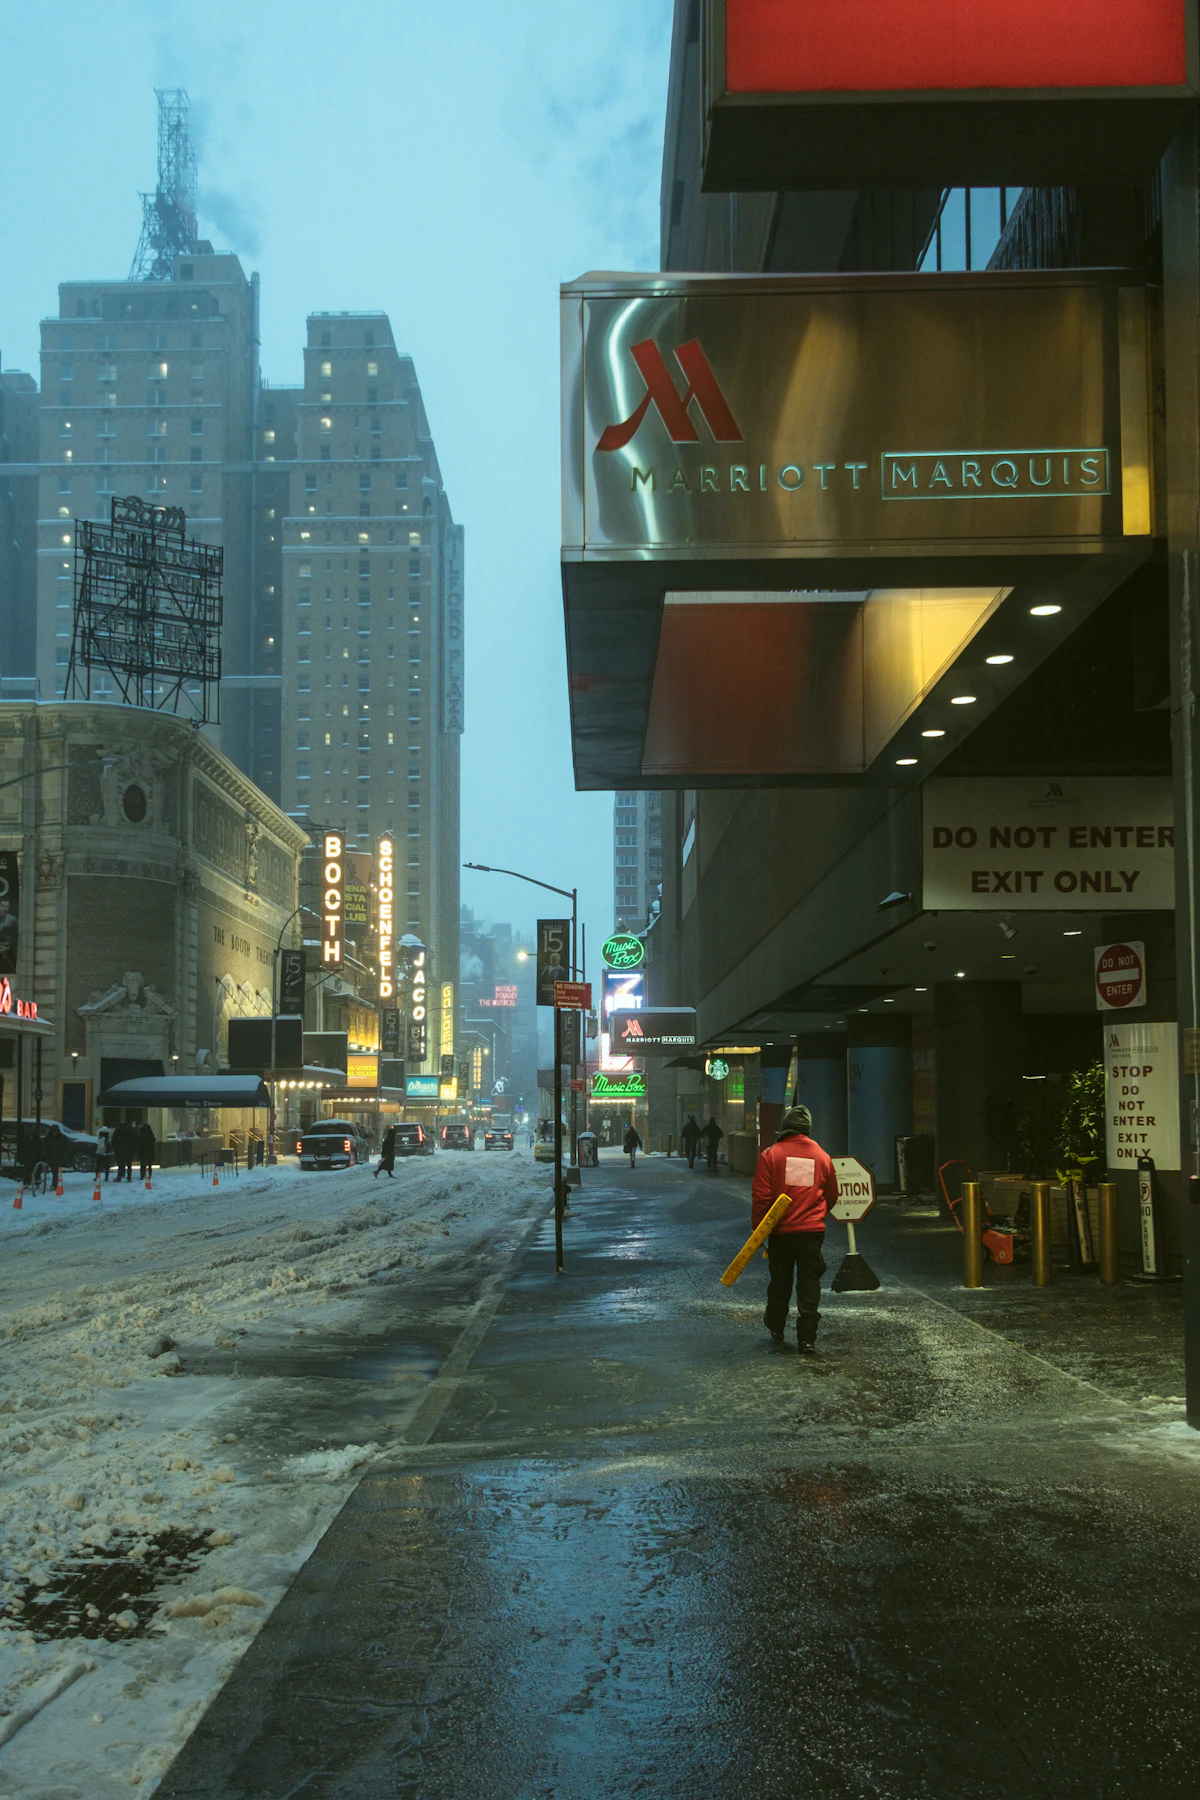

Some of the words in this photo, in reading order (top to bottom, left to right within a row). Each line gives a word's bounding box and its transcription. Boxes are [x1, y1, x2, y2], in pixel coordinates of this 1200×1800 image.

[632, 461, 868, 494] MARRIOTT
[890, 457, 1103, 489] MARQUIS
[933, 827, 978, 849] DO
[989, 827, 1057, 849] NOT
[1069, 826, 1175, 848] ENTER
[971, 870, 1043, 893] EXIT
[1054, 870, 1141, 893] ONLY
[324, 836, 342, 962] BOOTH
[378, 840, 394, 998] SCHOENFELD
[214, 926, 225, 946] THE
[231, 934, 250, 957] BOOTH
[543, 930, 563, 953] 15
[606, 940, 637, 955] Music
[286, 956, 300, 974] 15
[612, 951, 638, 965] Box
[1102, 960, 1114, 969] DO
[1118, 956, 1135, 967] NOT
[564, 984, 586, 992] STANDING
[1106, 984, 1133, 996] ENTER
[17, 999, 38, 1020] BAR
[1113, 1066, 1153, 1078] STOP
[595, 1073, 626, 1092] Music
[626, 1073, 645, 1092] Box
[1122, 1086, 1140, 1096] DO
[1119, 1101, 1145, 1111] NOT
[1114, 1116, 1156, 1126] ENTER
[1119, 1133, 1148, 1143] EXIT
[1117, 1148, 1151, 1158] ONLY
[838, 1182, 869, 1196] UTION
[1142, 1220, 1151, 1269] PARKING
